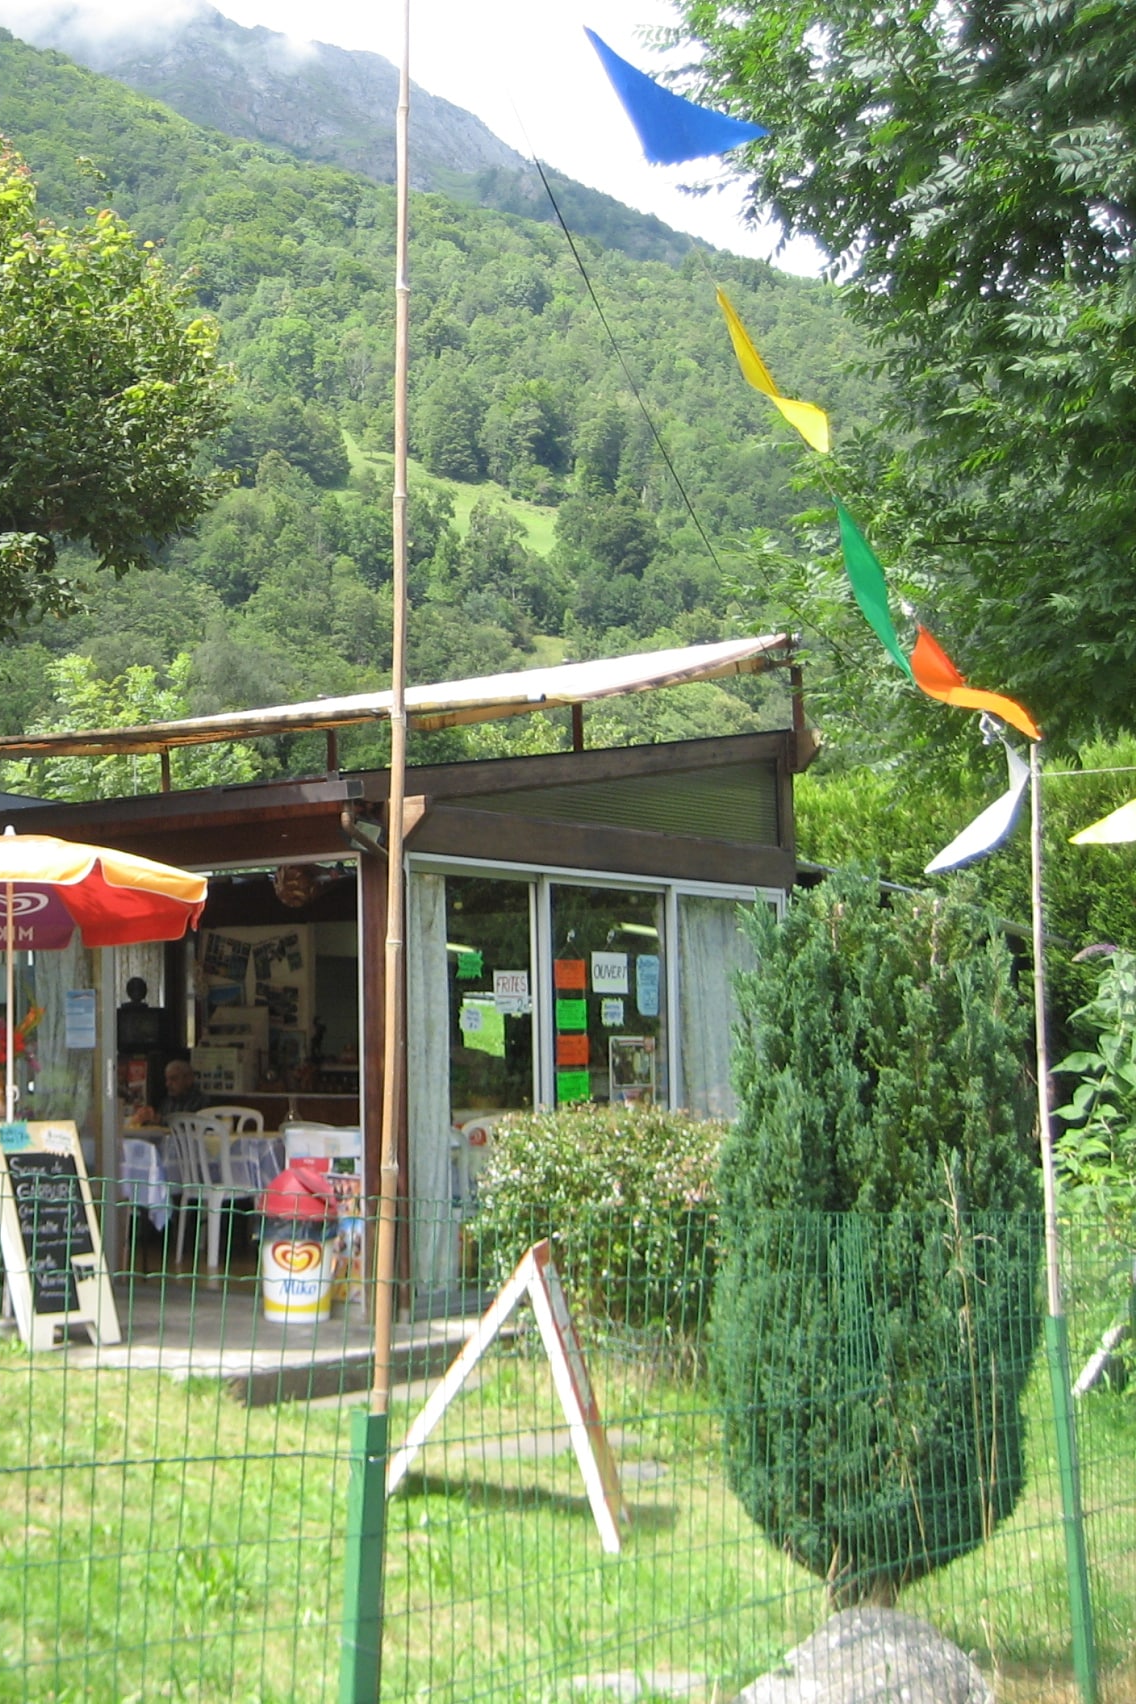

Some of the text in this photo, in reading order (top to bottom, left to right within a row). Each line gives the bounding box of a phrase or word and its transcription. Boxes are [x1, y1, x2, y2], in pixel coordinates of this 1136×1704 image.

[593, 963, 628, 980] OUVERT
[496, 975, 526, 993] FRITES
[279, 1279, 317, 1296] Miko
